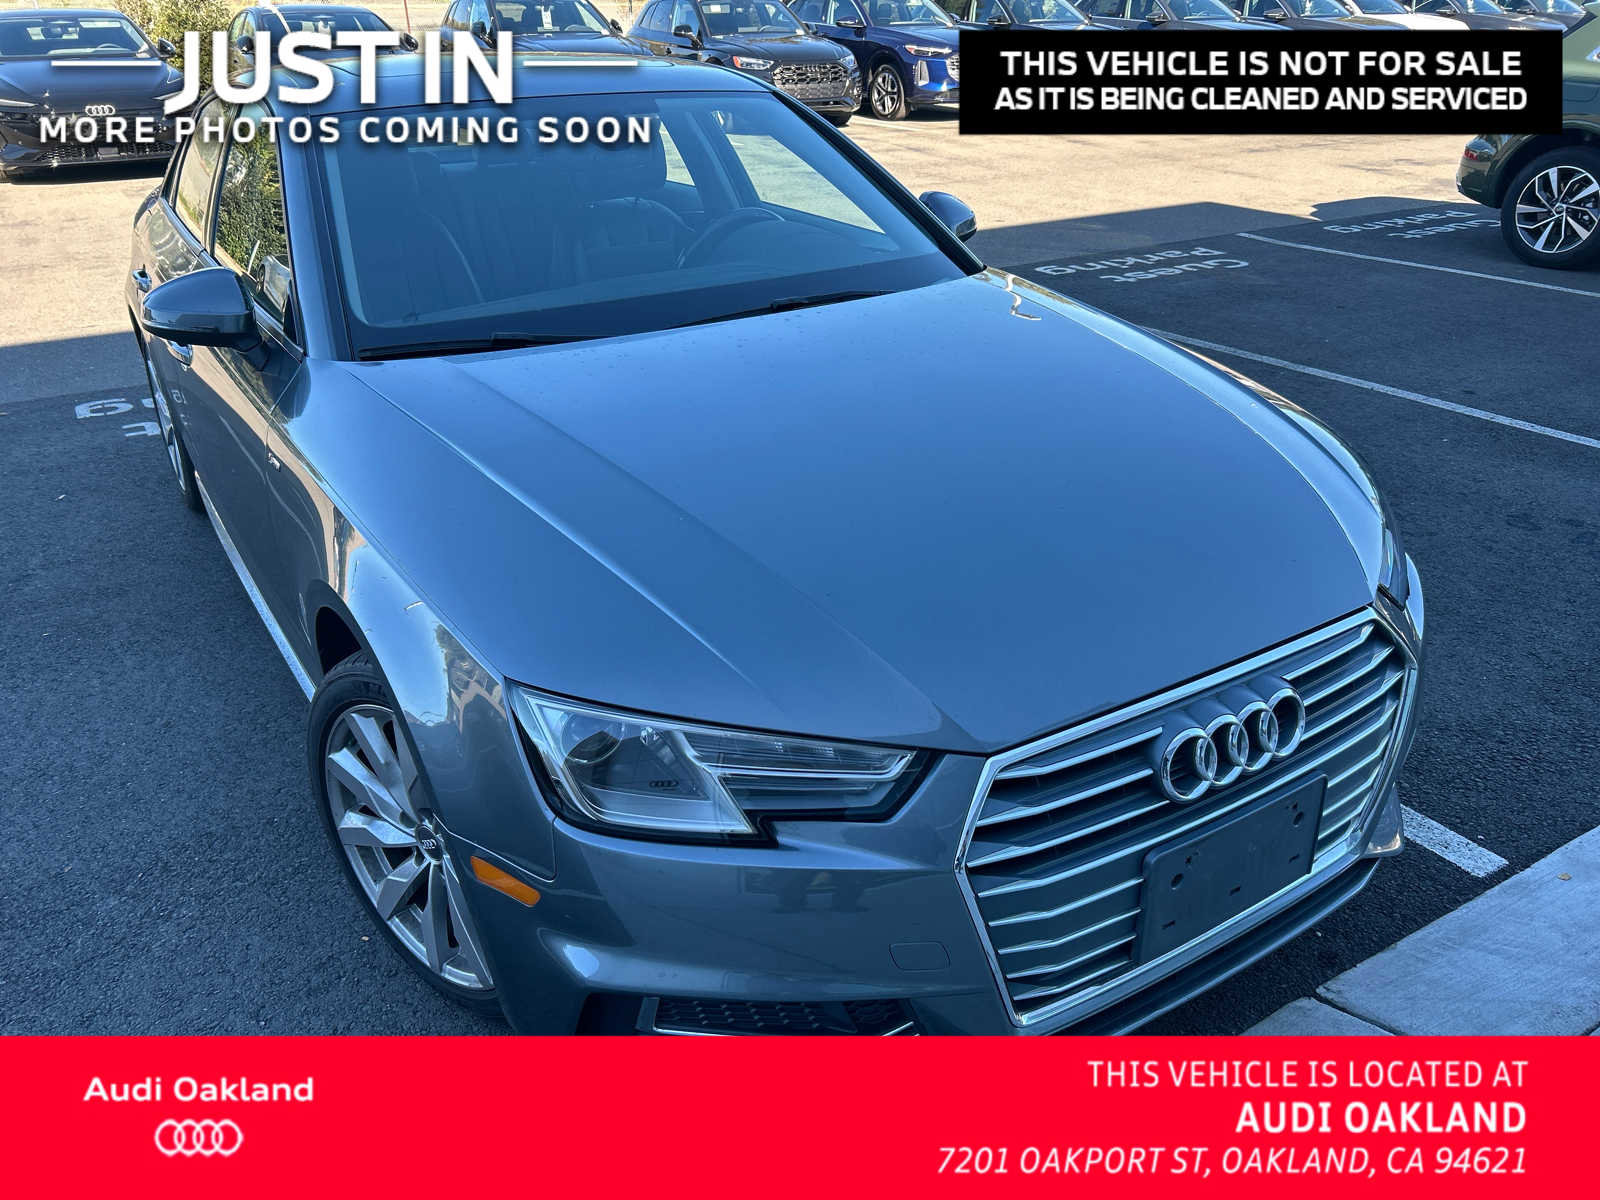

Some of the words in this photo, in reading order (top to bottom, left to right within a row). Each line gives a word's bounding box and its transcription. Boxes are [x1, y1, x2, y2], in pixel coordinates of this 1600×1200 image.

[1323, 210, 1478, 233] Parking
[1386, 219, 1501, 239] Guest
[1034, 246, 1227, 276] Parking
[1099, 258, 1249, 283] Guest
